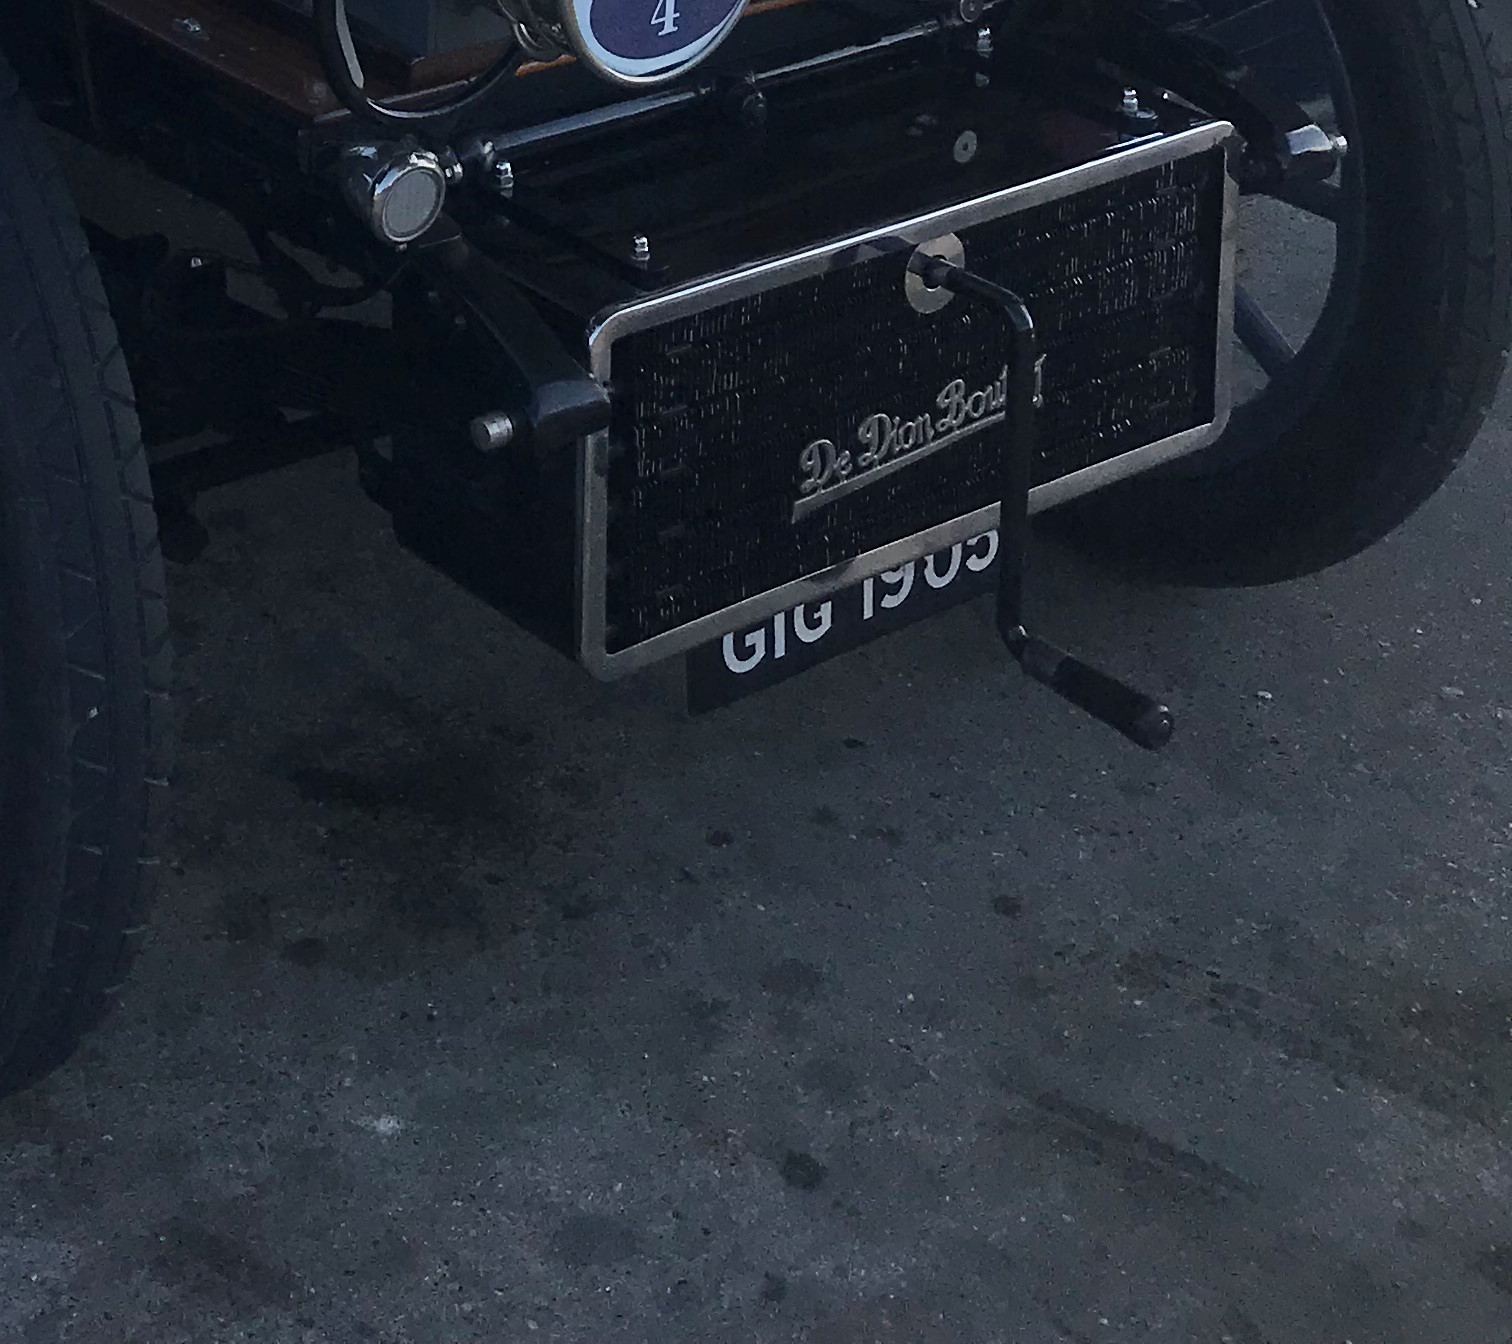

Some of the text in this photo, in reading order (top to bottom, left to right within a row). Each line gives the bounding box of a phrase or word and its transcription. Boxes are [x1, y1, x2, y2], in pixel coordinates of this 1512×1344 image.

[799, 438, 854, 497] De
[857, 412, 935, 467] Dion
[721, 528, 1000, 674] GIG 1905
